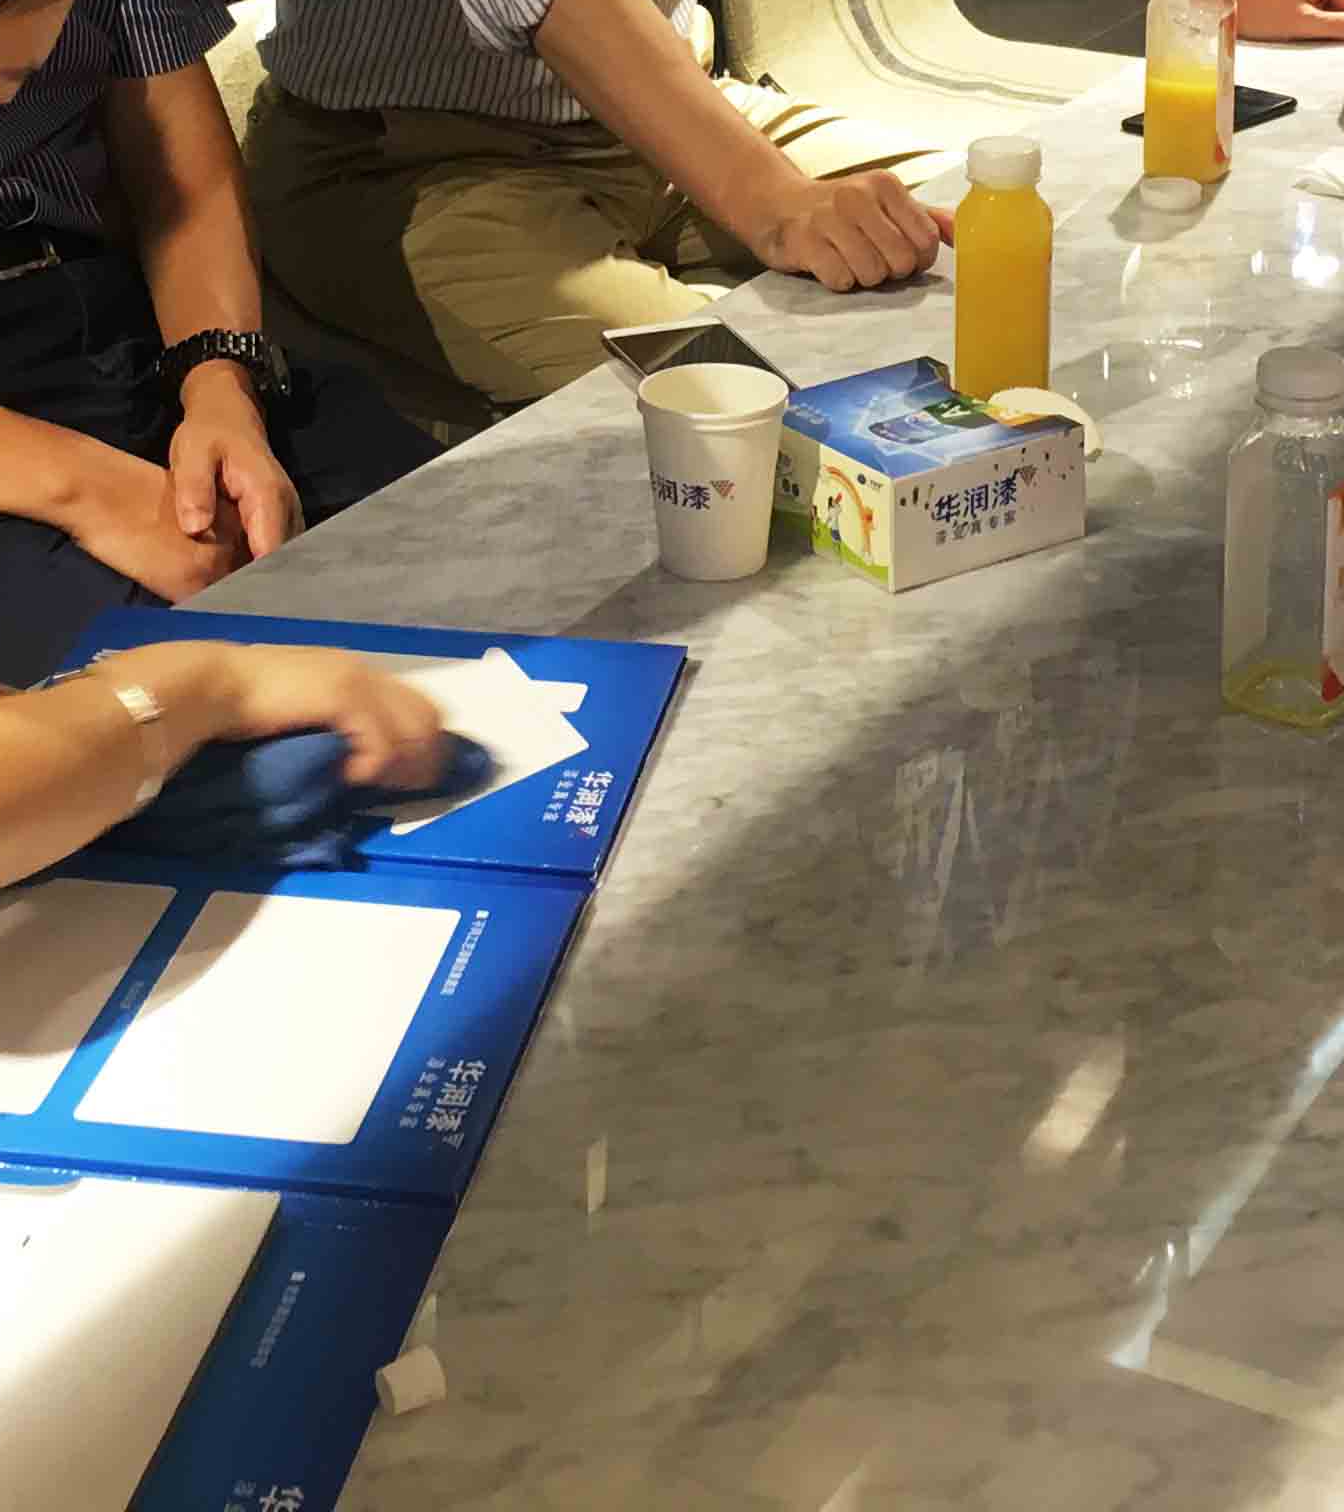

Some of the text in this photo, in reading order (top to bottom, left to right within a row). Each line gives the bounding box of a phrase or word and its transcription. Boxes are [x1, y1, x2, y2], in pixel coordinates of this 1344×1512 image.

[934, 475, 1017, 522] 华润漆
[564, 770, 614, 824] 华润漆
[425, 1059, 487, 1131] 华润漆
